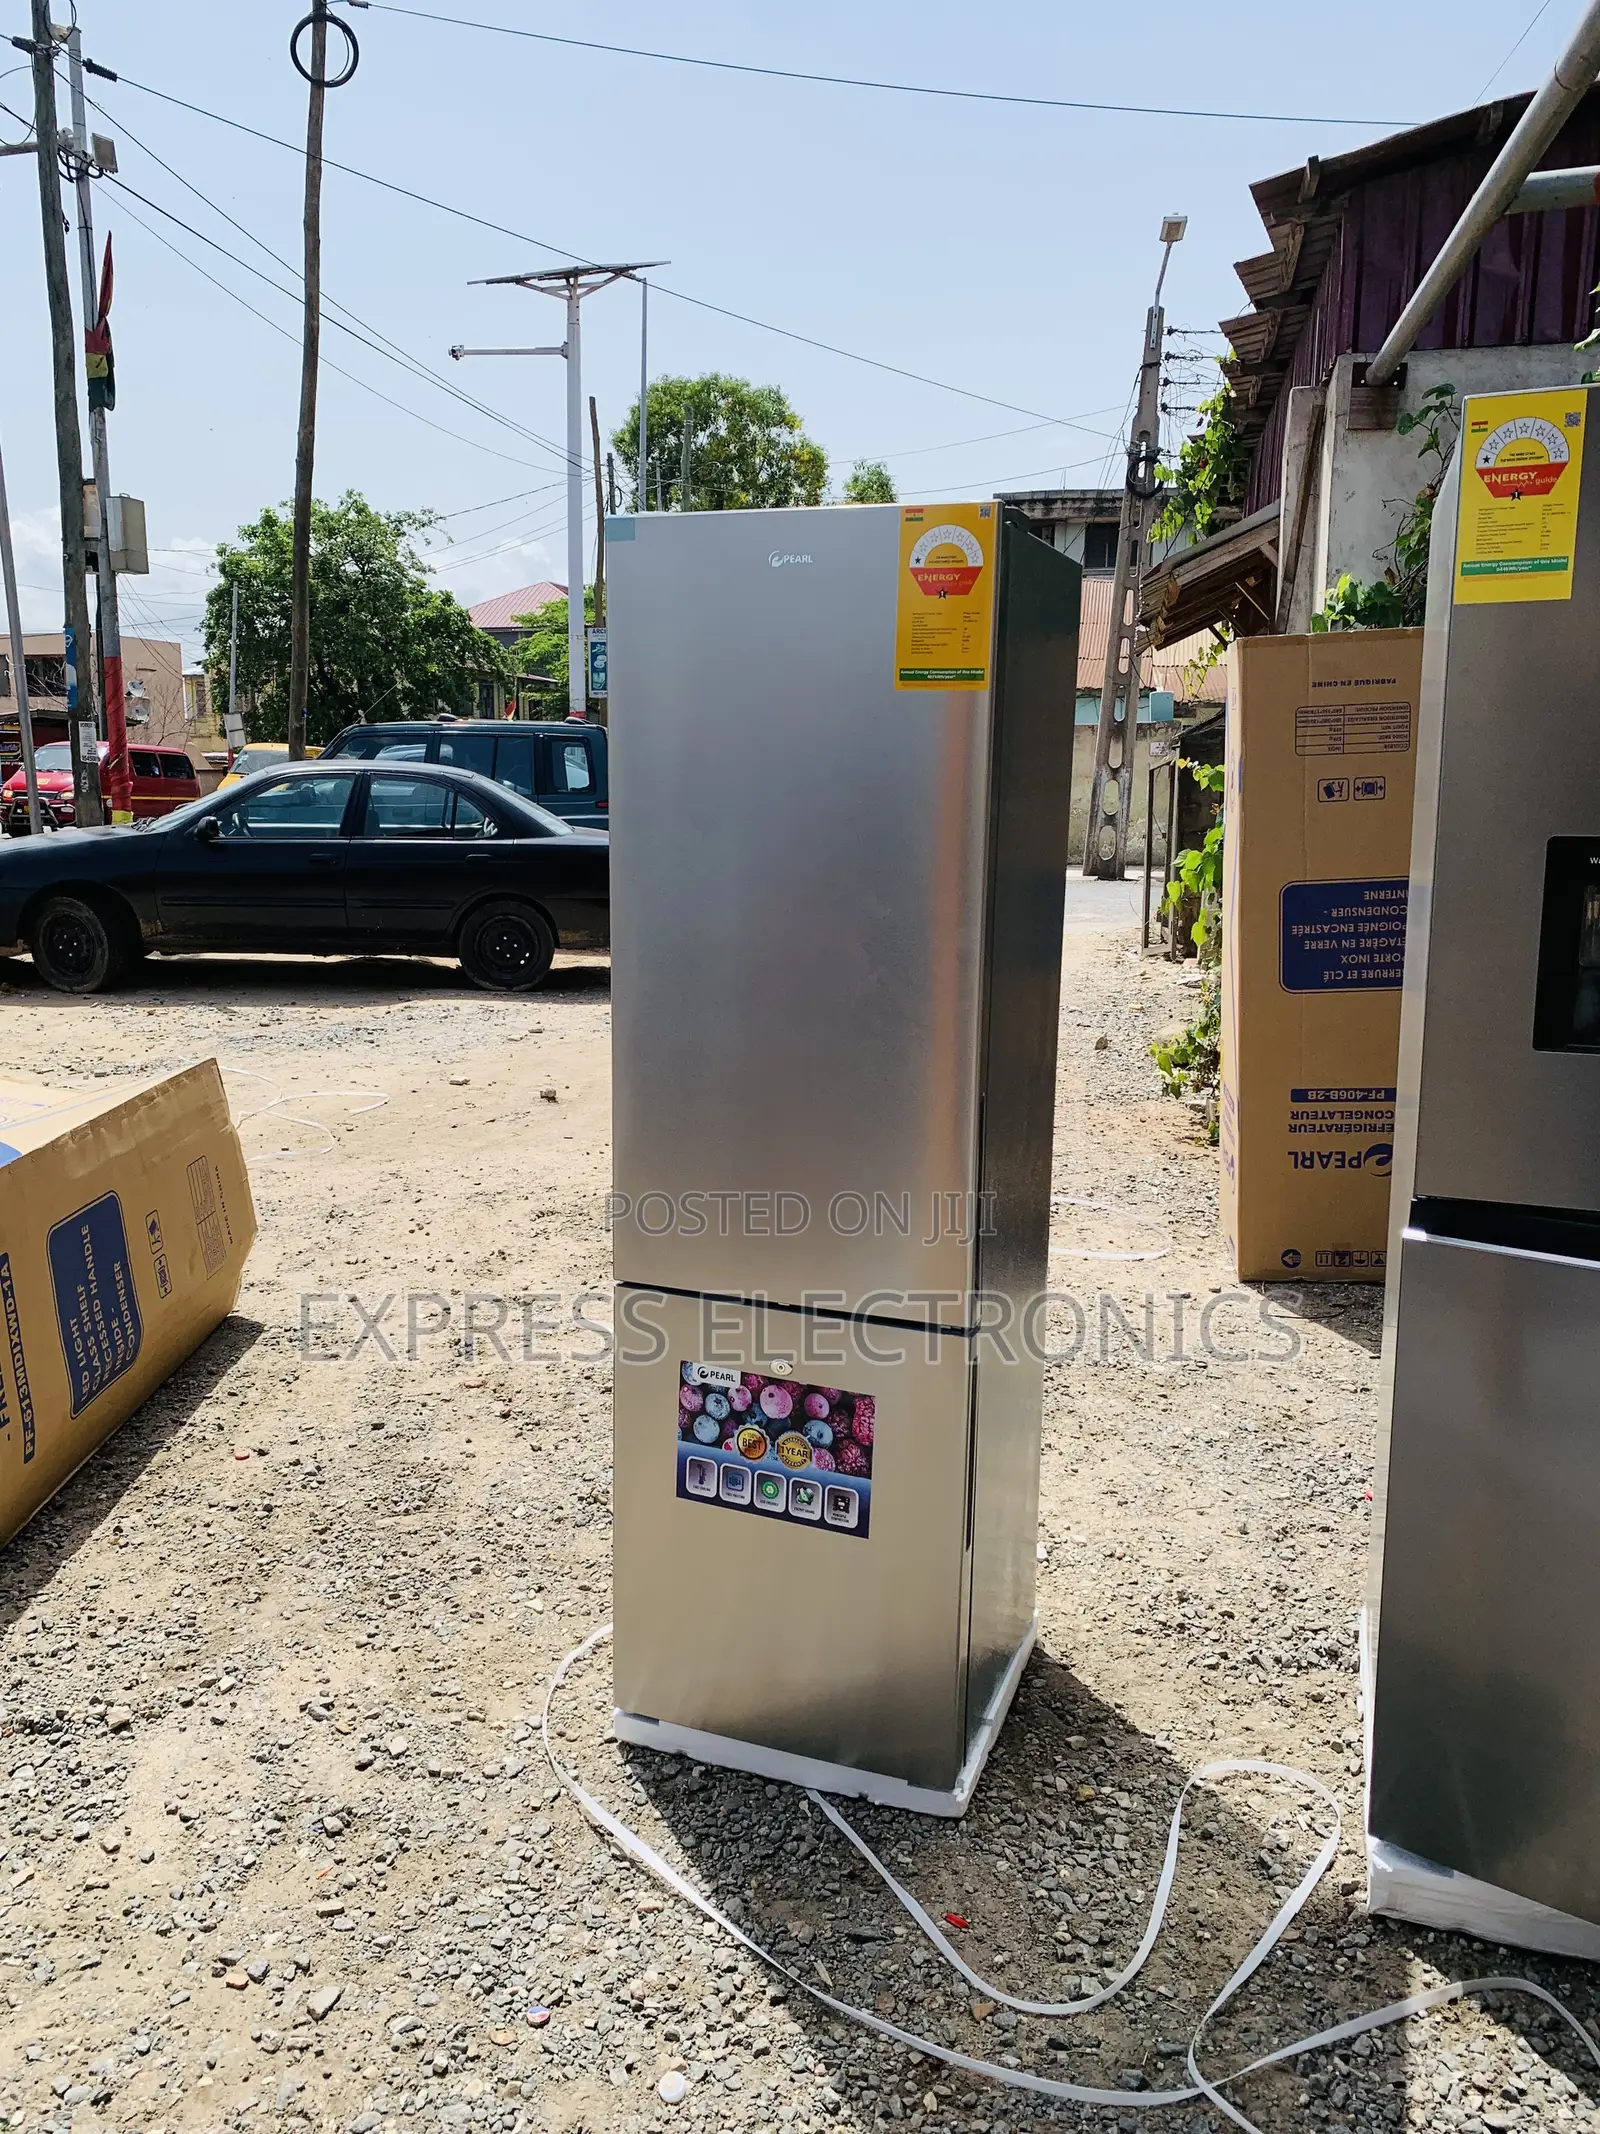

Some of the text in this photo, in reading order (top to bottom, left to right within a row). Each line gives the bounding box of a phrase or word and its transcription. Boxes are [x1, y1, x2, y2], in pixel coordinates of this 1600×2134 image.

[1484, 471, 1558, 486] ENERGY guide
[783, 554, 813, 564] PEARL
[917, 572, 961, 583] ENERGY
[1311, 680, 1339, 688] CHINE
[1354, 678, 1396, 688] FABRIQUÉ
[1331, 905, 1408, 917] CONDENSUER
[1291, 923, 1354, 937] ENCASTRÉE
[1304, 939, 1338, 950] VERRE
[1341, 938, 1356, 948] EN
[1340, 954, 1370, 964] INOX
[1323, 968, 1404, 983] ERRURE ET CLÉ
[1307, 1089, 1385, 1099] PF-406B-2B
[1288, 1123, 1395, 1135] ÉFRIGÉRATEUR
[1287, 1150, 1362, 1170] PEARL
[81, 1223, 114, 1381] RECESSED HANDLE
[113, 1260, 137, 1361] CONDENSER
[77, 1282, 102, 1391] GLASS SHELF
[110, 1316, 125, 1370] INSIDE
[1, 1262, 34, 1455] PF-613MDIXWD-1A
[69, 1316, 91, 1401] LED LIGHT
[709, 1370, 736, 1383] PEARL
[742, 1438, 762, 1451] BEST
[785, 1446, 809, 1459] YEAR
